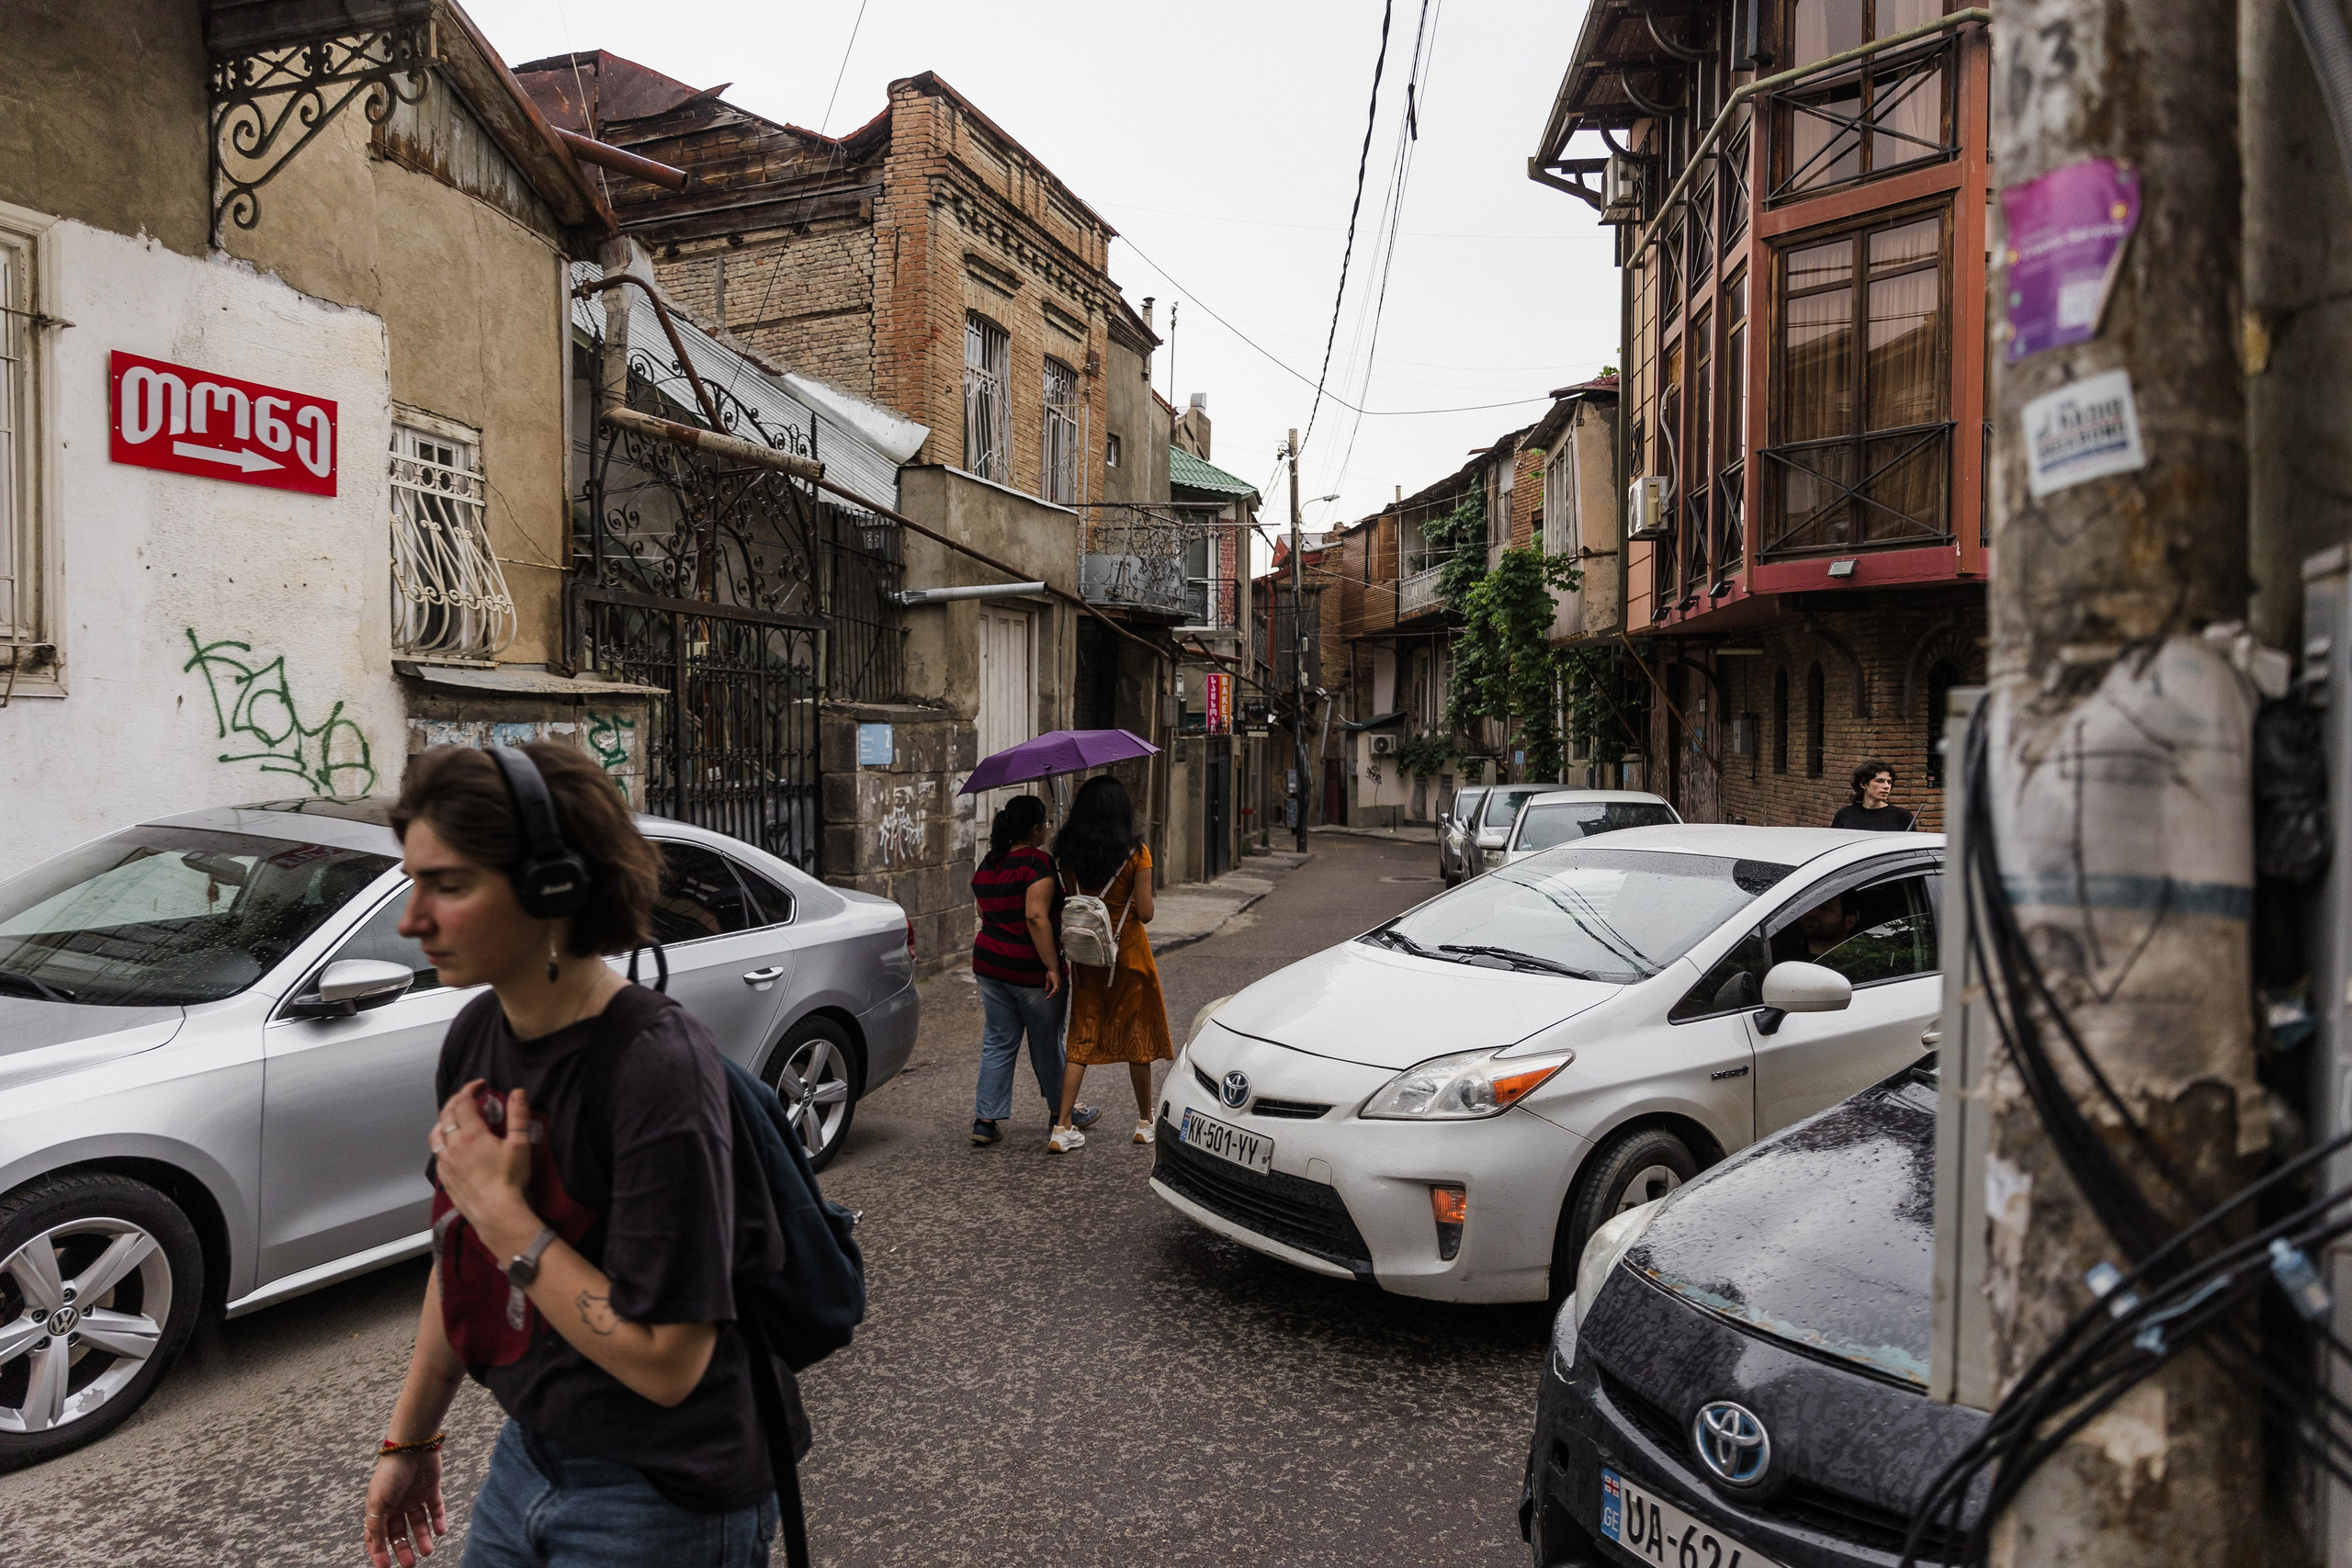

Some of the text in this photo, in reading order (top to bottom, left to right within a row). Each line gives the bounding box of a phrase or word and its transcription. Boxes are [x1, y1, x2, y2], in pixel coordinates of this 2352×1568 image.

[119, 365, 332, 479] თონე
[885, 728, 892, 750] 2
[1187, 1114, 1260, 1166] KK-501-YY
[1603, 1506, 1620, 1533] GE
